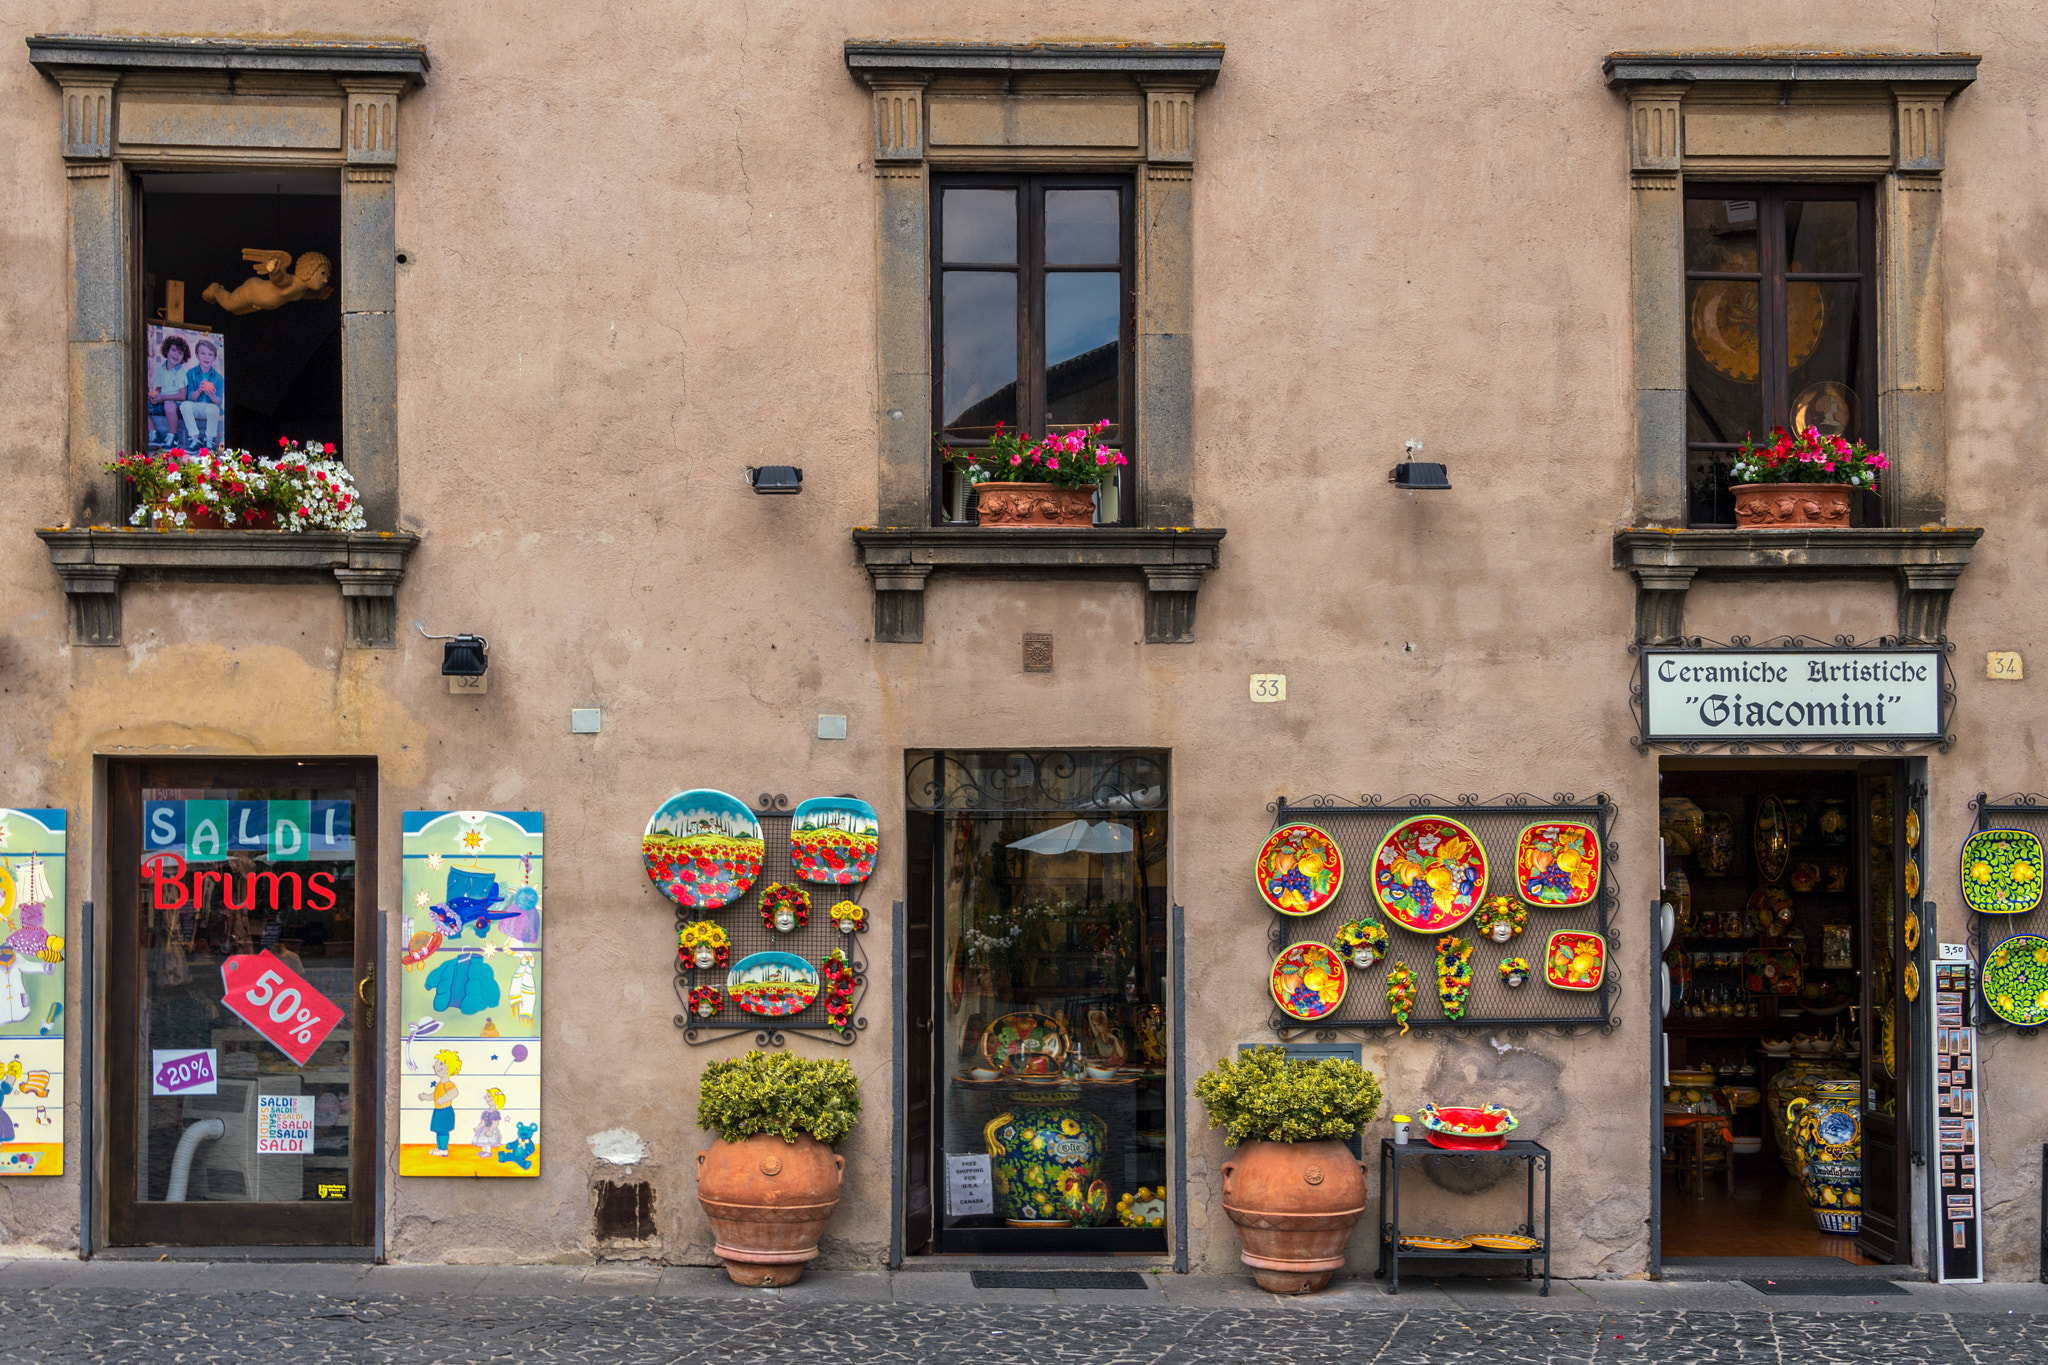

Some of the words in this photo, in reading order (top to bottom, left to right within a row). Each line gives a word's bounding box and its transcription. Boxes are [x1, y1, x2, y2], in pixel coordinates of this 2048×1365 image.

[1658, 660, 1788, 683] Ceramiche
[1807, 660, 1928, 683] Artistiche
[1994, 658, 2017, 674] 34
[1256, 679, 1279, 697] 33
[151, 807, 336, 855] SALDI
[141, 852, 337, 911] Brums
[1944, 945, 1964, 956] 3,50
[246, 969, 321, 1044] 50%
[167, 1058, 210, 1087] 20%
[260, 1097, 293, 1107] SALDI
[260, 1107, 269, 1138] SALDI
[269, 1113, 277, 1139] SALDI
[281, 1120, 313, 1130] SALDI
[276, 1129, 308, 1139] SALDI
[259, 1139, 303, 1152] SALDI
[956, 1167, 984, 1175] SHIPPING
